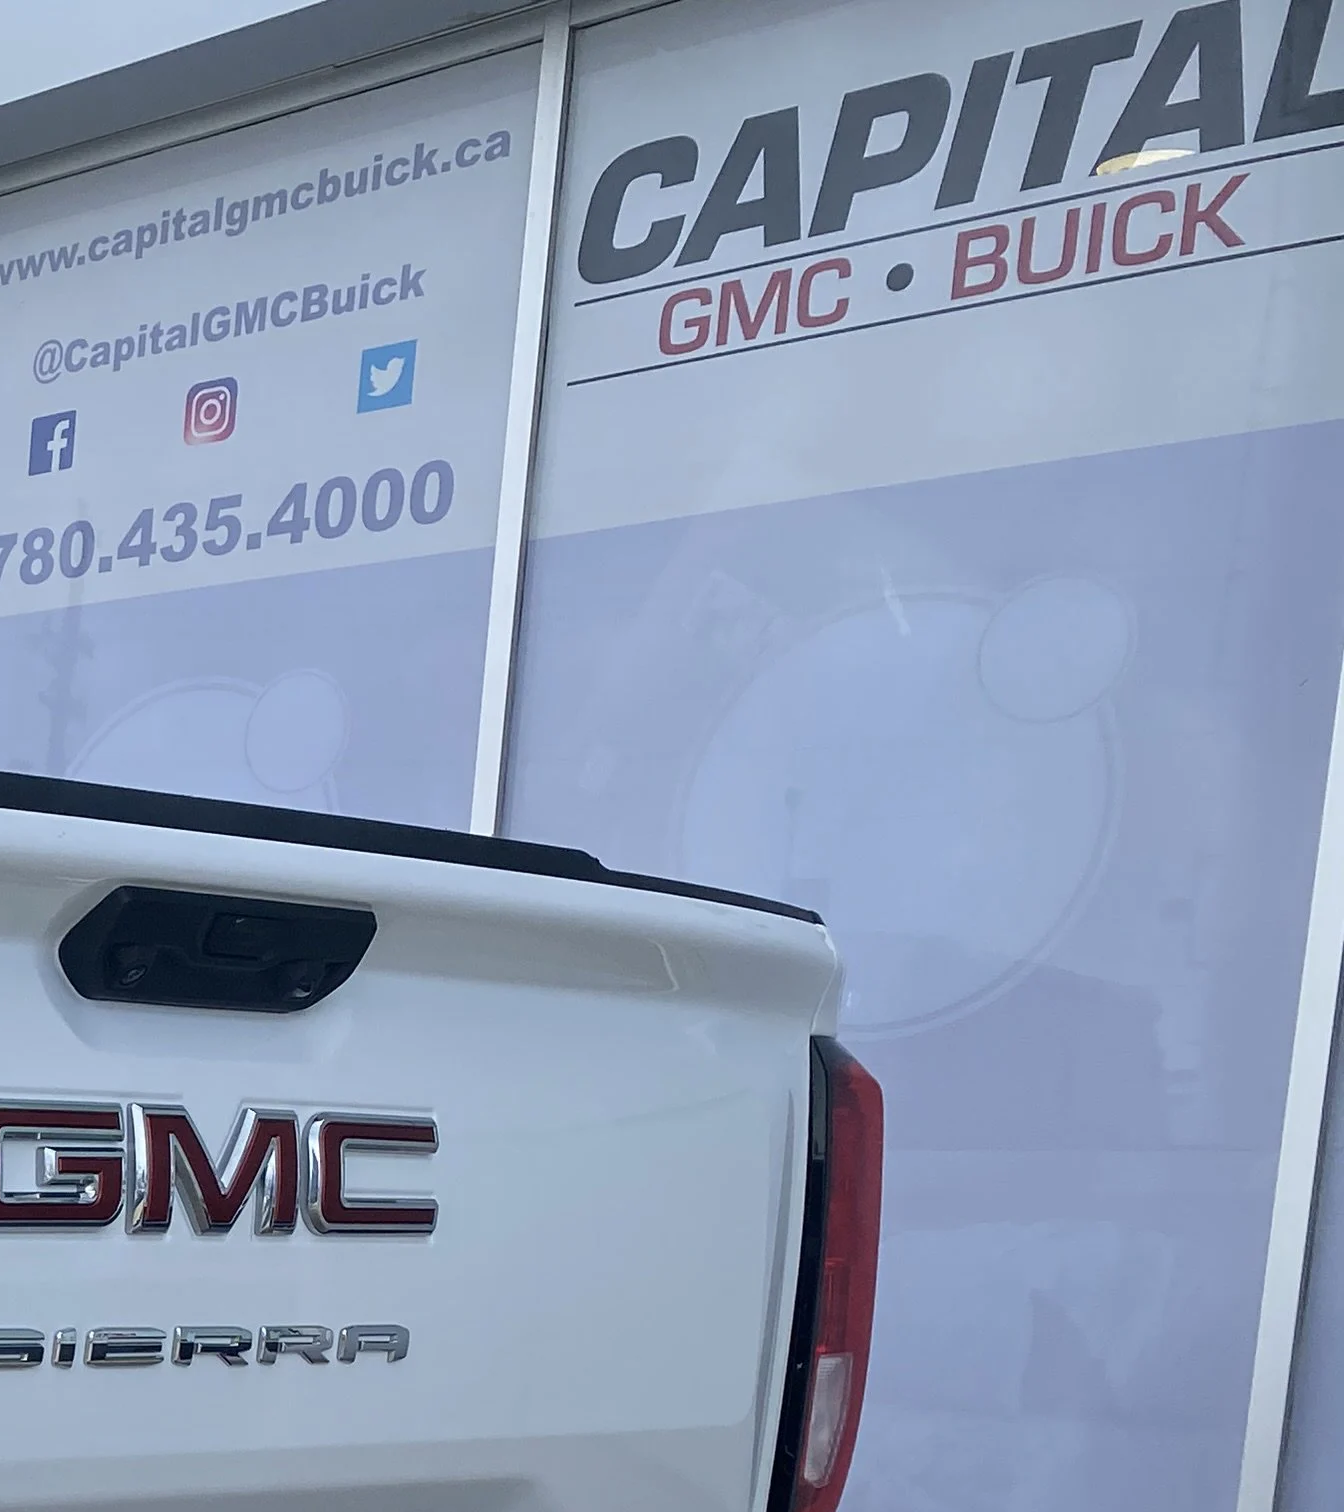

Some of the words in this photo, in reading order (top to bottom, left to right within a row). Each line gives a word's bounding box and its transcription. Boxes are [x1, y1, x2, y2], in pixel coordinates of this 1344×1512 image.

[577, 0, 1344, 286] CAPITAL
[32, 263, 428, 384] @CapitalGMCBuick
[658, 257, 853, 356] GMC
[950, 173, 1251, 301] BUICK
